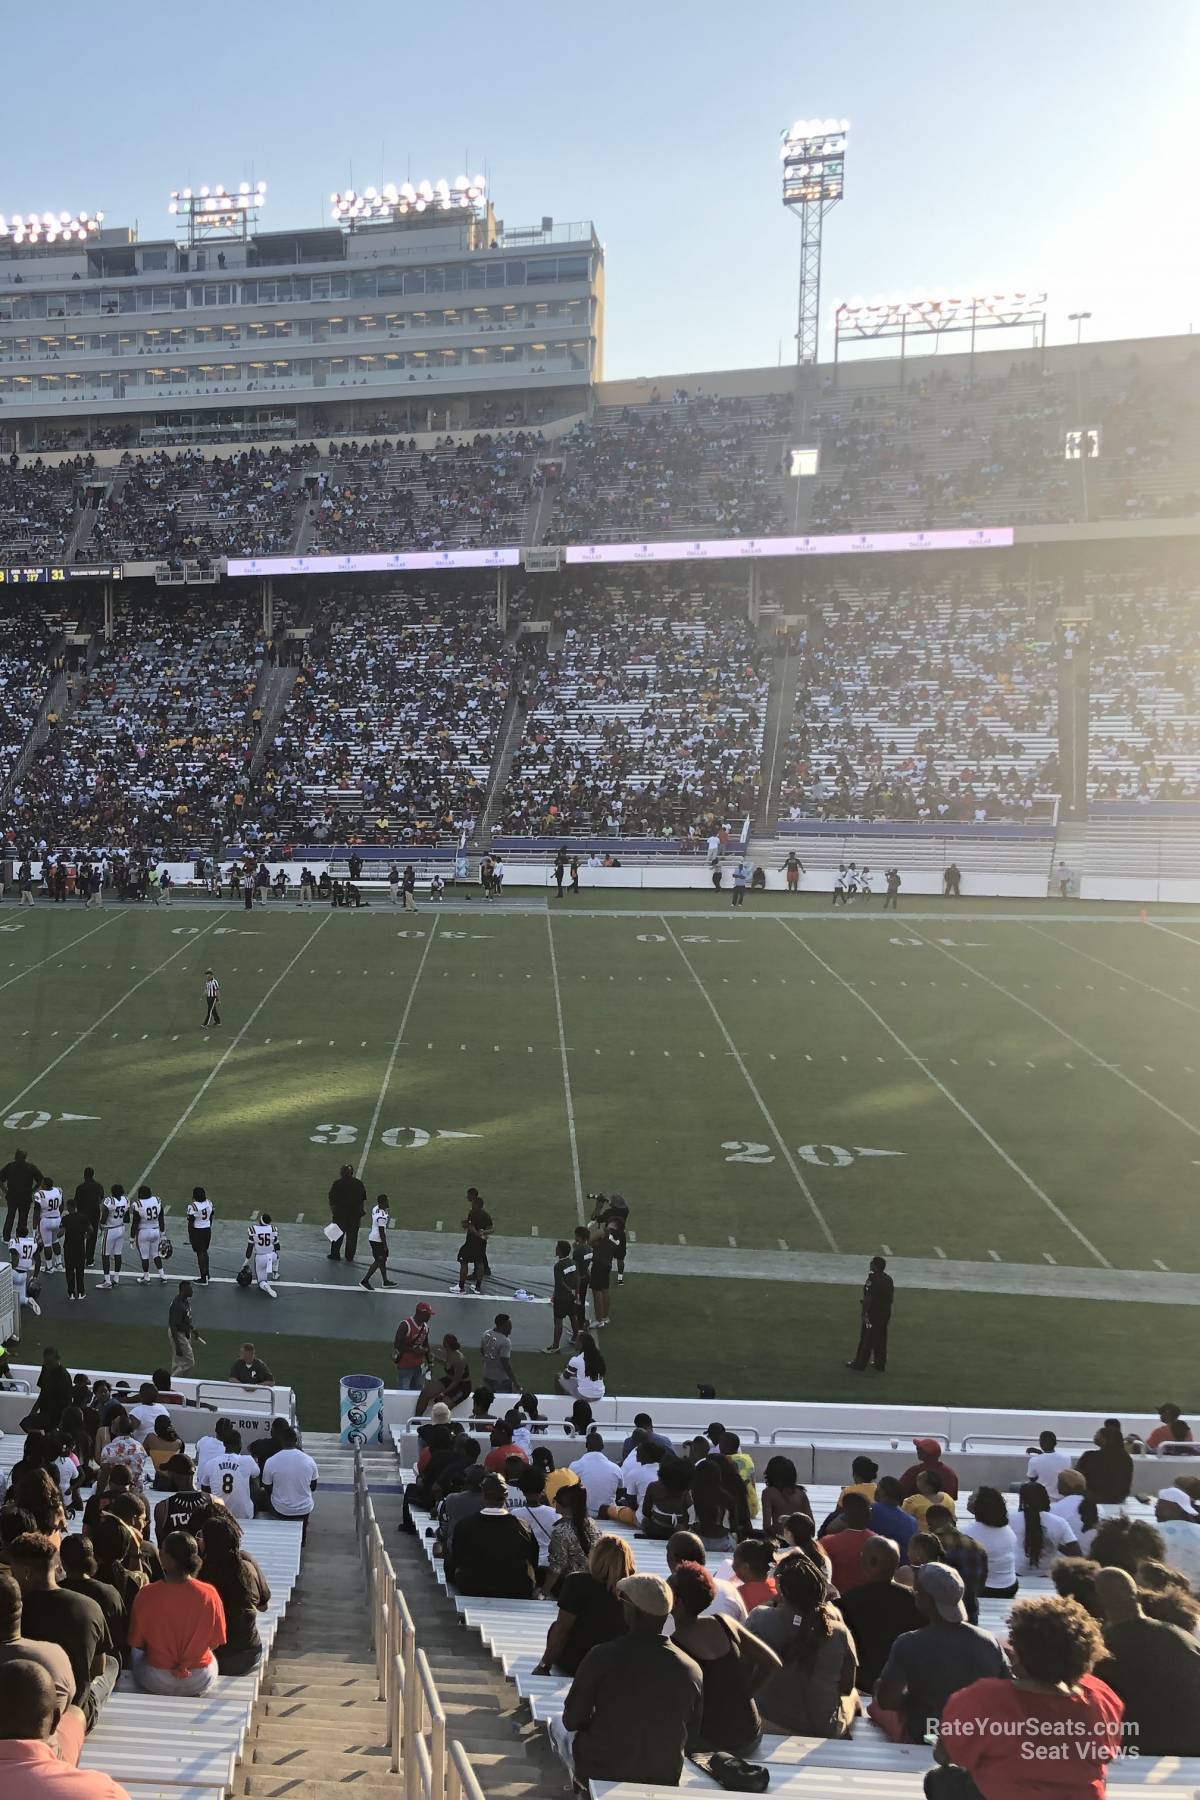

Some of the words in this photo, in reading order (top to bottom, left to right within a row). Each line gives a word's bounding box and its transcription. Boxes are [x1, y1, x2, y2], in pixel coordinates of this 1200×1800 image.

[51, 569, 65, 580] 31
[309, 1123, 431, 1148] 30
[719, 1140, 855, 1168] 20
[48, 1198, 59, 1212] 90
[147, 1206, 158, 1221] 93
[202, 1209, 208, 1220] 9
[258, 1233, 271, 1246] 56
[23, 1245, 33, 1259] 97
[239, 1421, 259, 1431] ROW
[218, 1462, 240, 1472] BRYANT
[222, 1473, 234, 1494] 8
